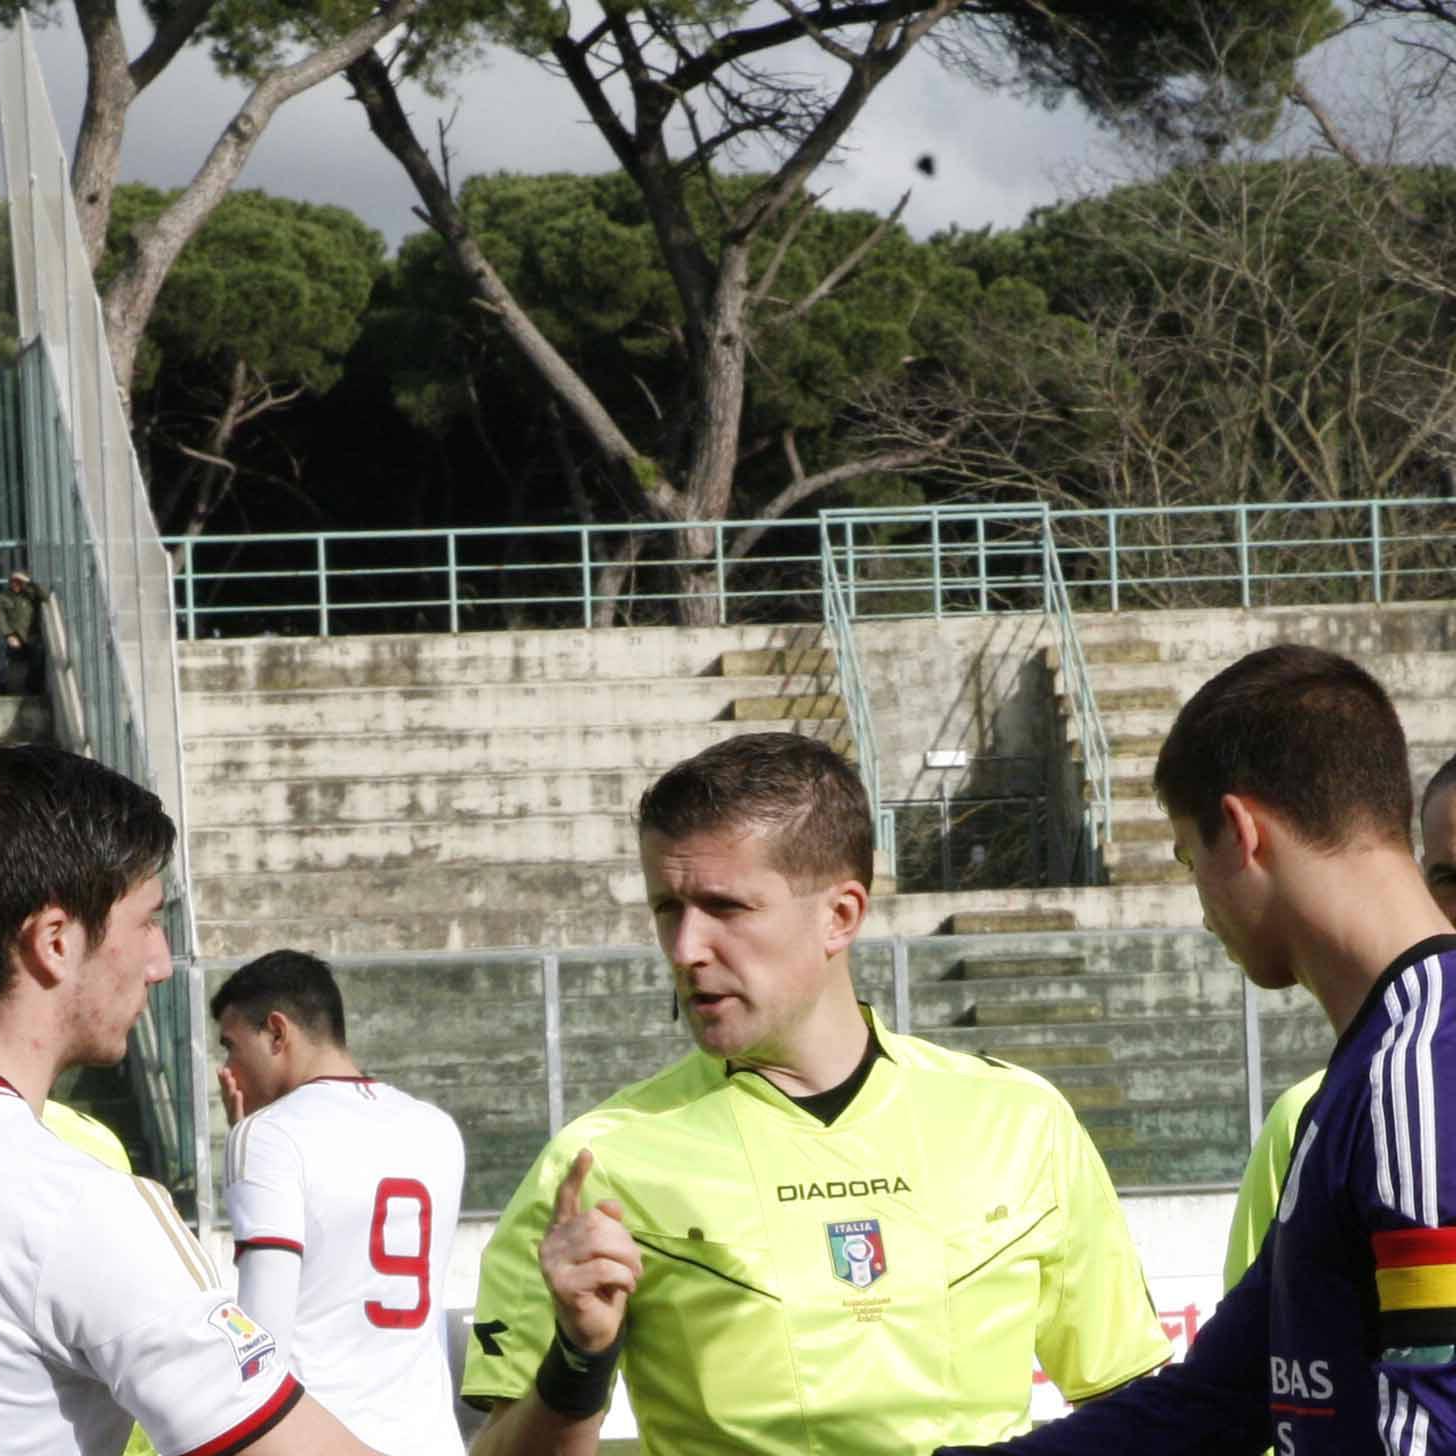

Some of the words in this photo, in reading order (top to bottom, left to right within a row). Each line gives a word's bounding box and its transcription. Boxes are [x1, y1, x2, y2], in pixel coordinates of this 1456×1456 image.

[777, 1177, 912, 1202] DIADORA
[834, 1222, 873, 1234] ITALIA
[364, 1177, 433, 1330] 9
